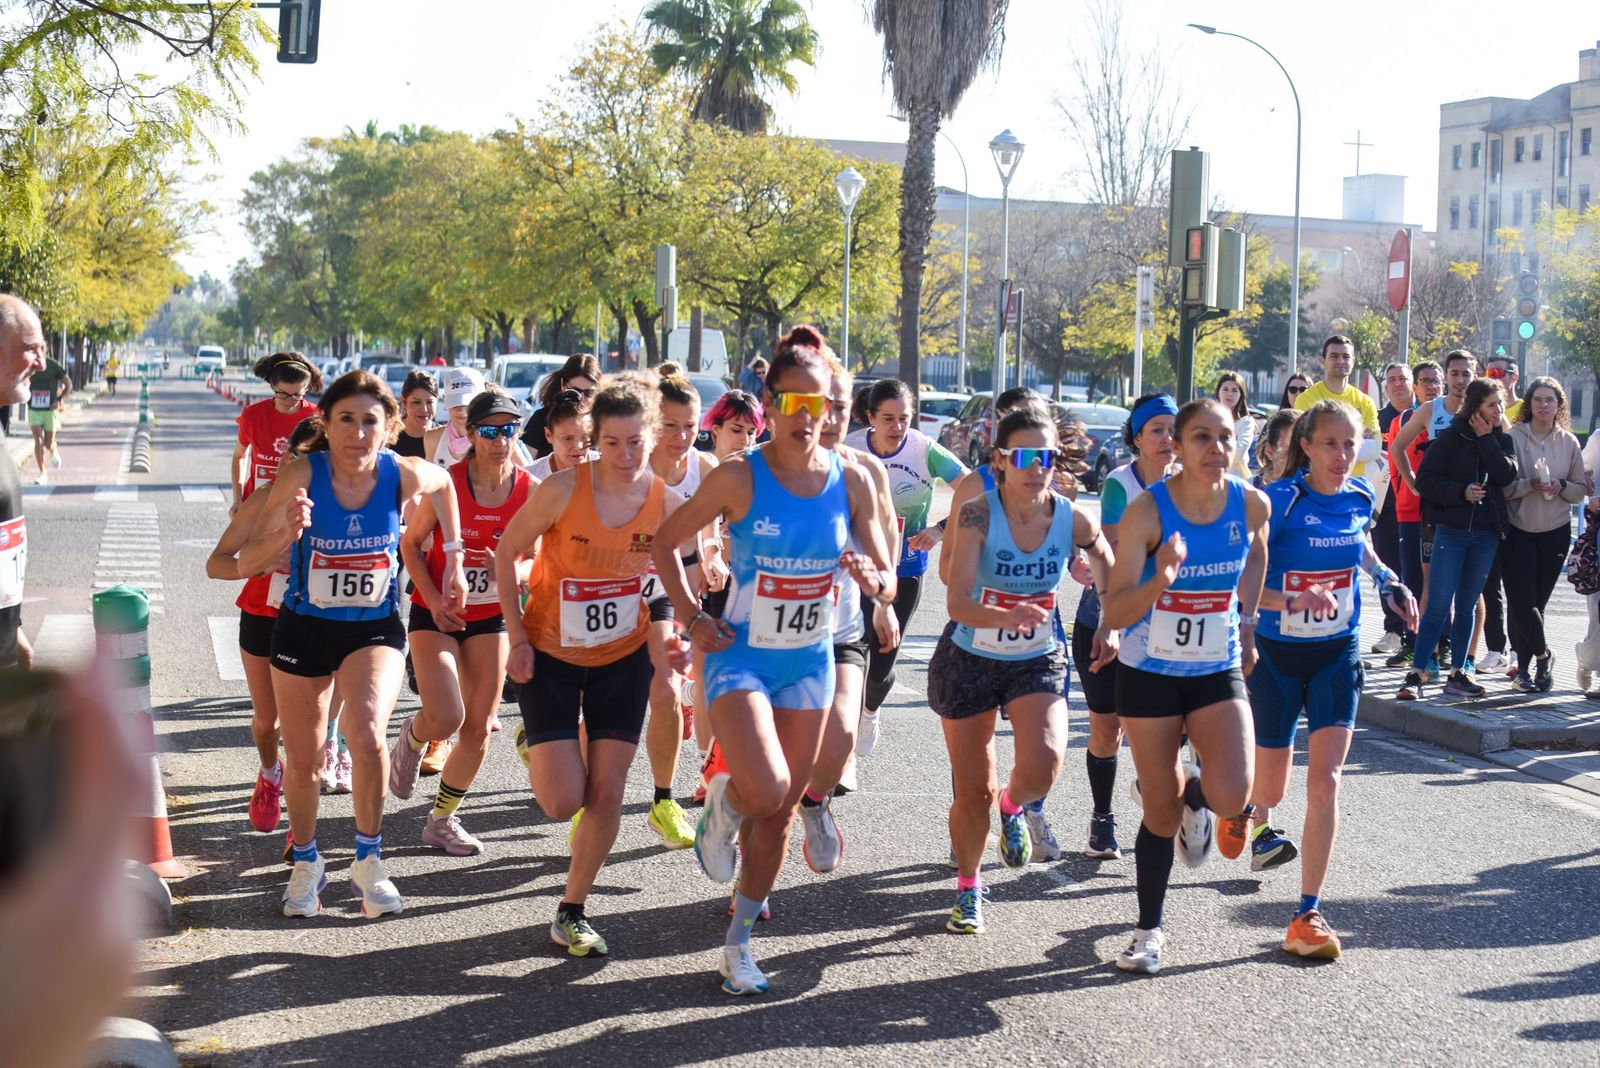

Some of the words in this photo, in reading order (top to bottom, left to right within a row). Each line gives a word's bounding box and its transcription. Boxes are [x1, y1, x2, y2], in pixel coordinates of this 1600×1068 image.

[309, 532, 396, 550] TROTASIERRA
[995, 557, 1058, 580] nerja
[328, 572, 374, 598] 156
[585, 601, 618, 632] 86
[774, 602, 821, 634] 145
[1175, 617, 1206, 647] 91
[277, 653, 299, 664] NIKE
